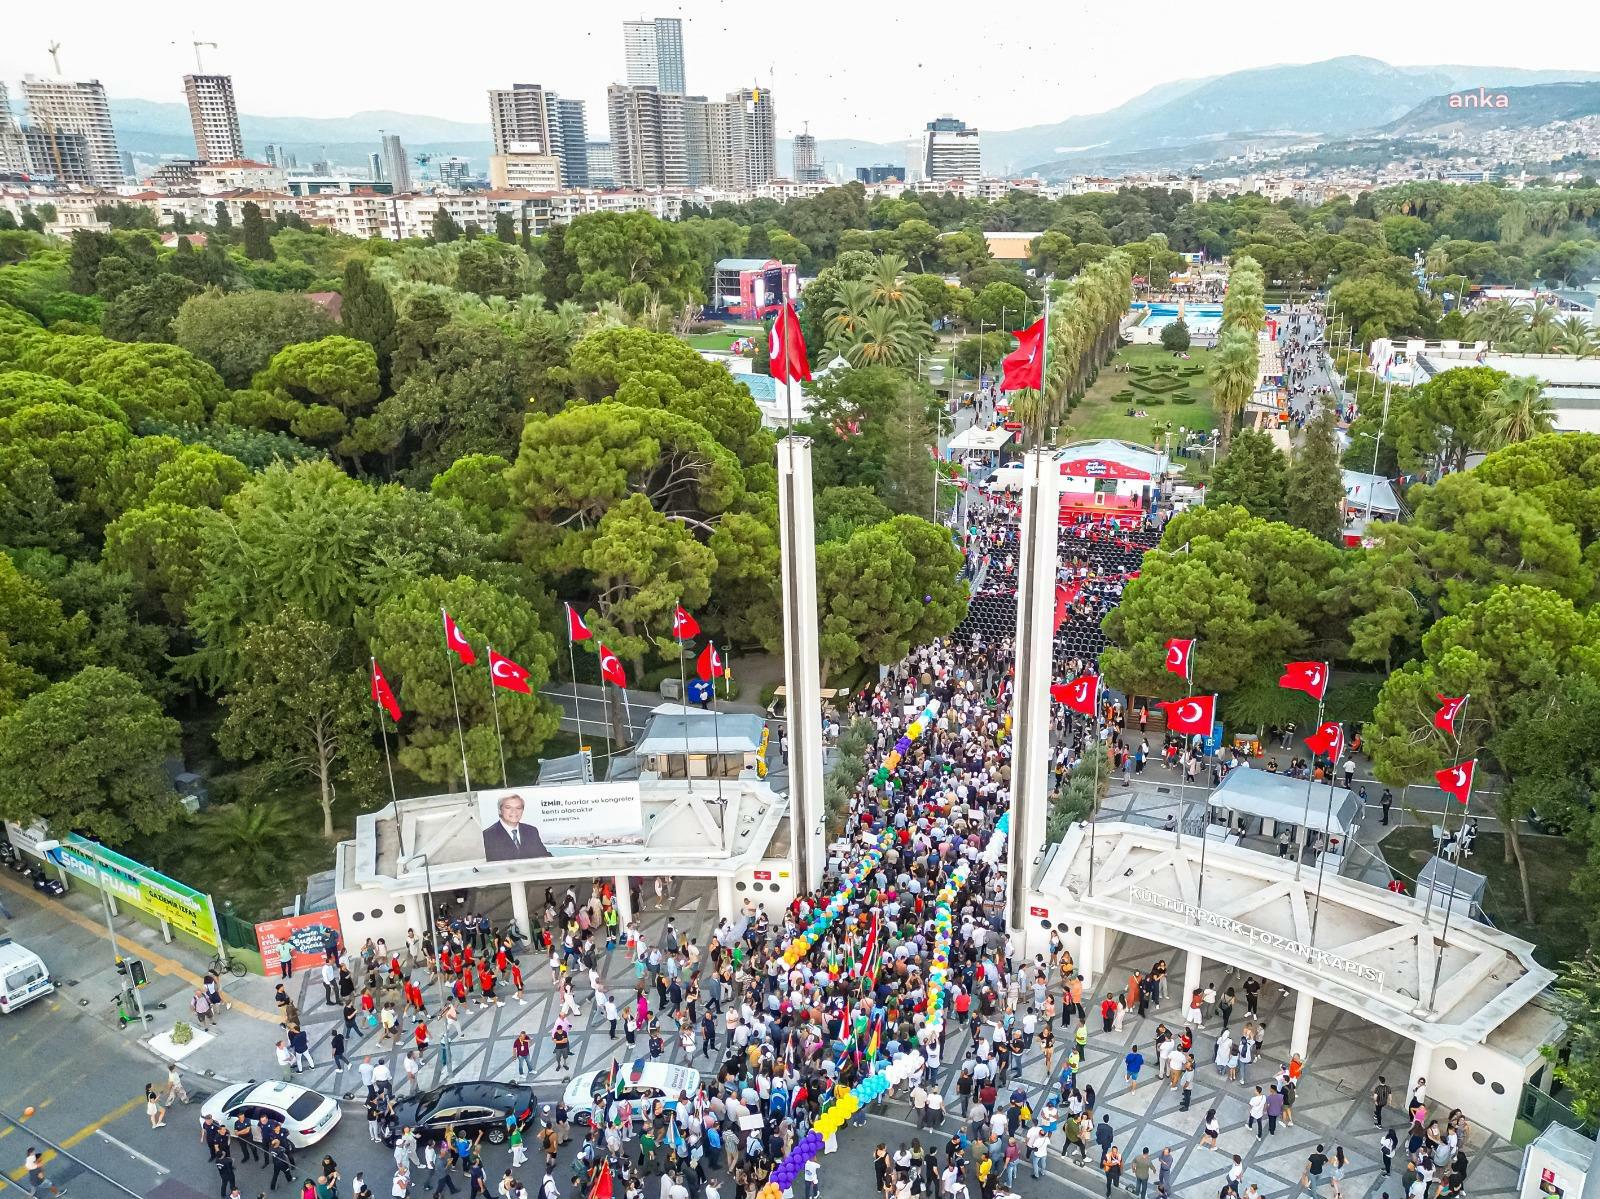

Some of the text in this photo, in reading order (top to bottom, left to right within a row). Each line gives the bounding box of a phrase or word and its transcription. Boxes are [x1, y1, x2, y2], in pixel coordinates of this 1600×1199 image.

[601, 796, 634, 804] kongreler
[60, 851, 97, 879] SPOR
[100, 870, 141, 902] FUARI
